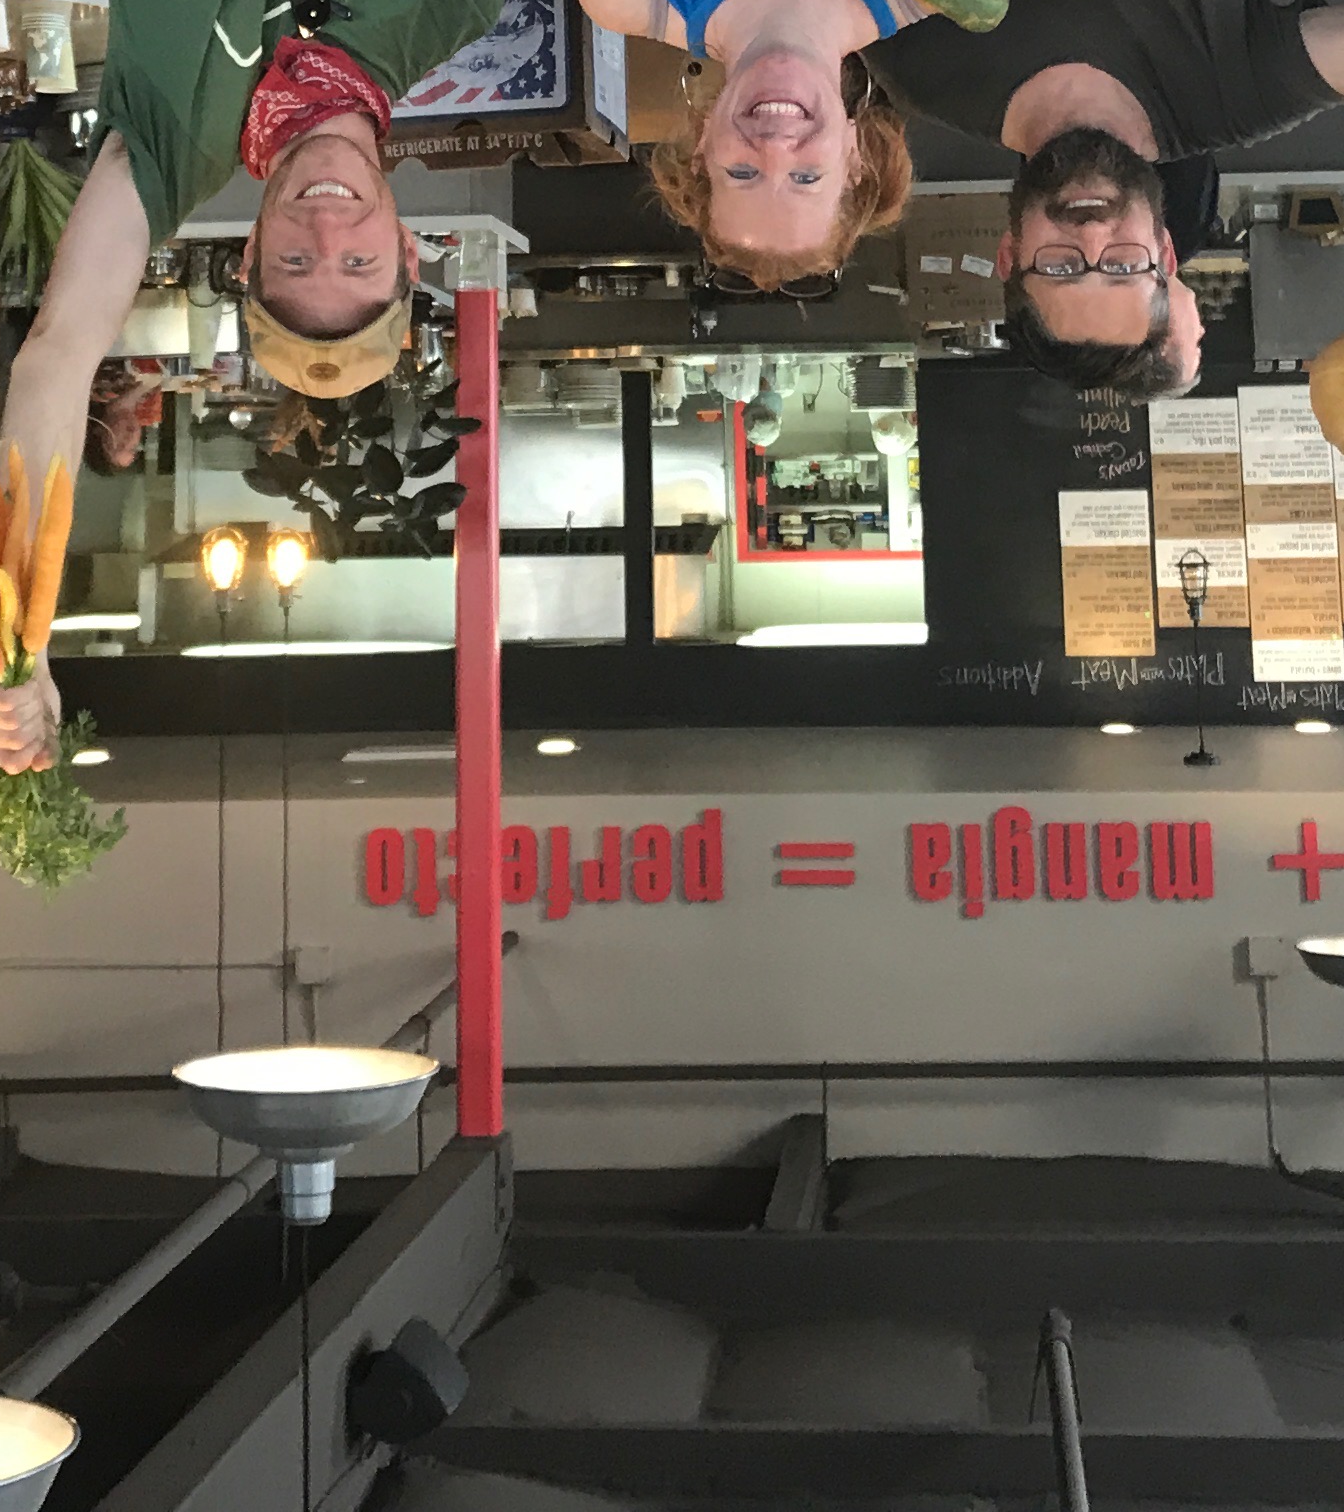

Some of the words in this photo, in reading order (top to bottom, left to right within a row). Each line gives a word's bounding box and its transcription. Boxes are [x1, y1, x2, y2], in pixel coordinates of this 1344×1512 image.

[384, 136, 462, 158] REFRIGERATE
[467, 136, 480, 150] AT
[1080, 411, 1131, 437] Peach
[938, 661, 1042, 696] Additions
[1071, 658, 1139, 691] Meat
[1167, 652, 1226, 687] Plates
[360, 808, 725, 920] perfeto
[907, 806, 1216, 918] mangia
